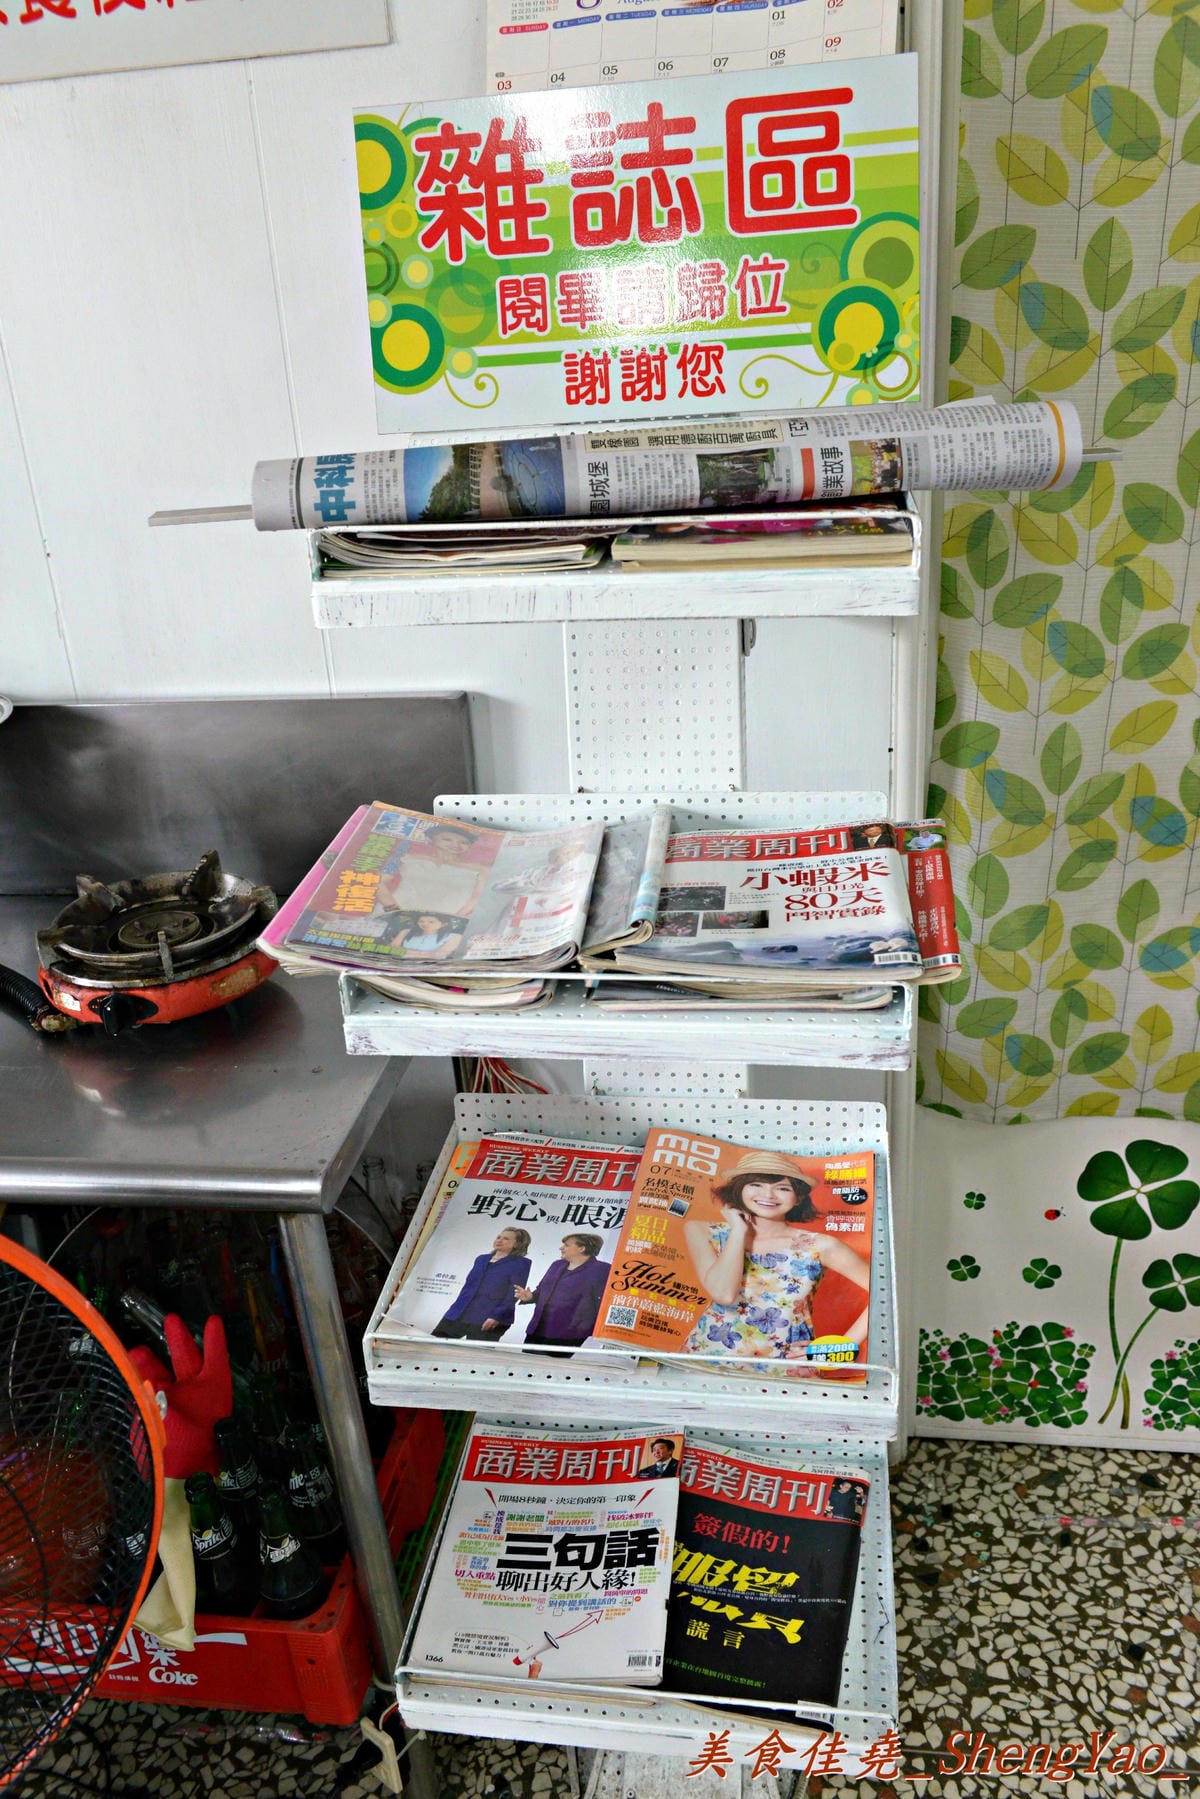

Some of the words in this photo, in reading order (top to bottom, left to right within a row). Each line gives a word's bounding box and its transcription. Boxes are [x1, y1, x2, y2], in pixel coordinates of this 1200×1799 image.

[771, 10, 786, 21] 01
[826, 0, 844, 9] 02
[577, 16, 600, 24] MONDAY
[824, 36, 842, 48] 09
[657, 61, 675, 71] 06
[713, 57, 729, 68] 07
[769, 49, 787, 61] 08
[550, 72, 566, 83] 04
[602, 65, 619, 76] 05
[496, 80, 513, 91] 03
[414, 87, 859, 263] 雜誌區
[497, 256, 788, 336] 閱畢請歸位
[563, 343, 727, 406] 謝謝您
[667, 830, 850, 859] 商業周刊
[740, 861, 892, 891] 小蝦米
[784, 887, 884, 911] 80天
[476, 1149, 641, 1188] 商業周刊
[650, 1164, 672, 1176] 07
[645, 1177, 695, 1196] 名模衣櫃
[614, 1259, 676, 1285] Hot
[611, 1276, 707, 1305] Summer
[473, 1443, 642, 1480] 商業周刊
[679, 1453, 828, 1516] 商業周刊
[194, 1533, 221, 1551] Sprite
[692, 1512, 792, 1555] 簽假的!
[496, 1526, 660, 1571] 三句話
[496, 1568, 636, 1593] 聊出好人緣!
[686, 1618, 747, 1650] 謊言
[424, 1654, 444, 1663] 1366
[148, 1665, 200, 1686] Coke
